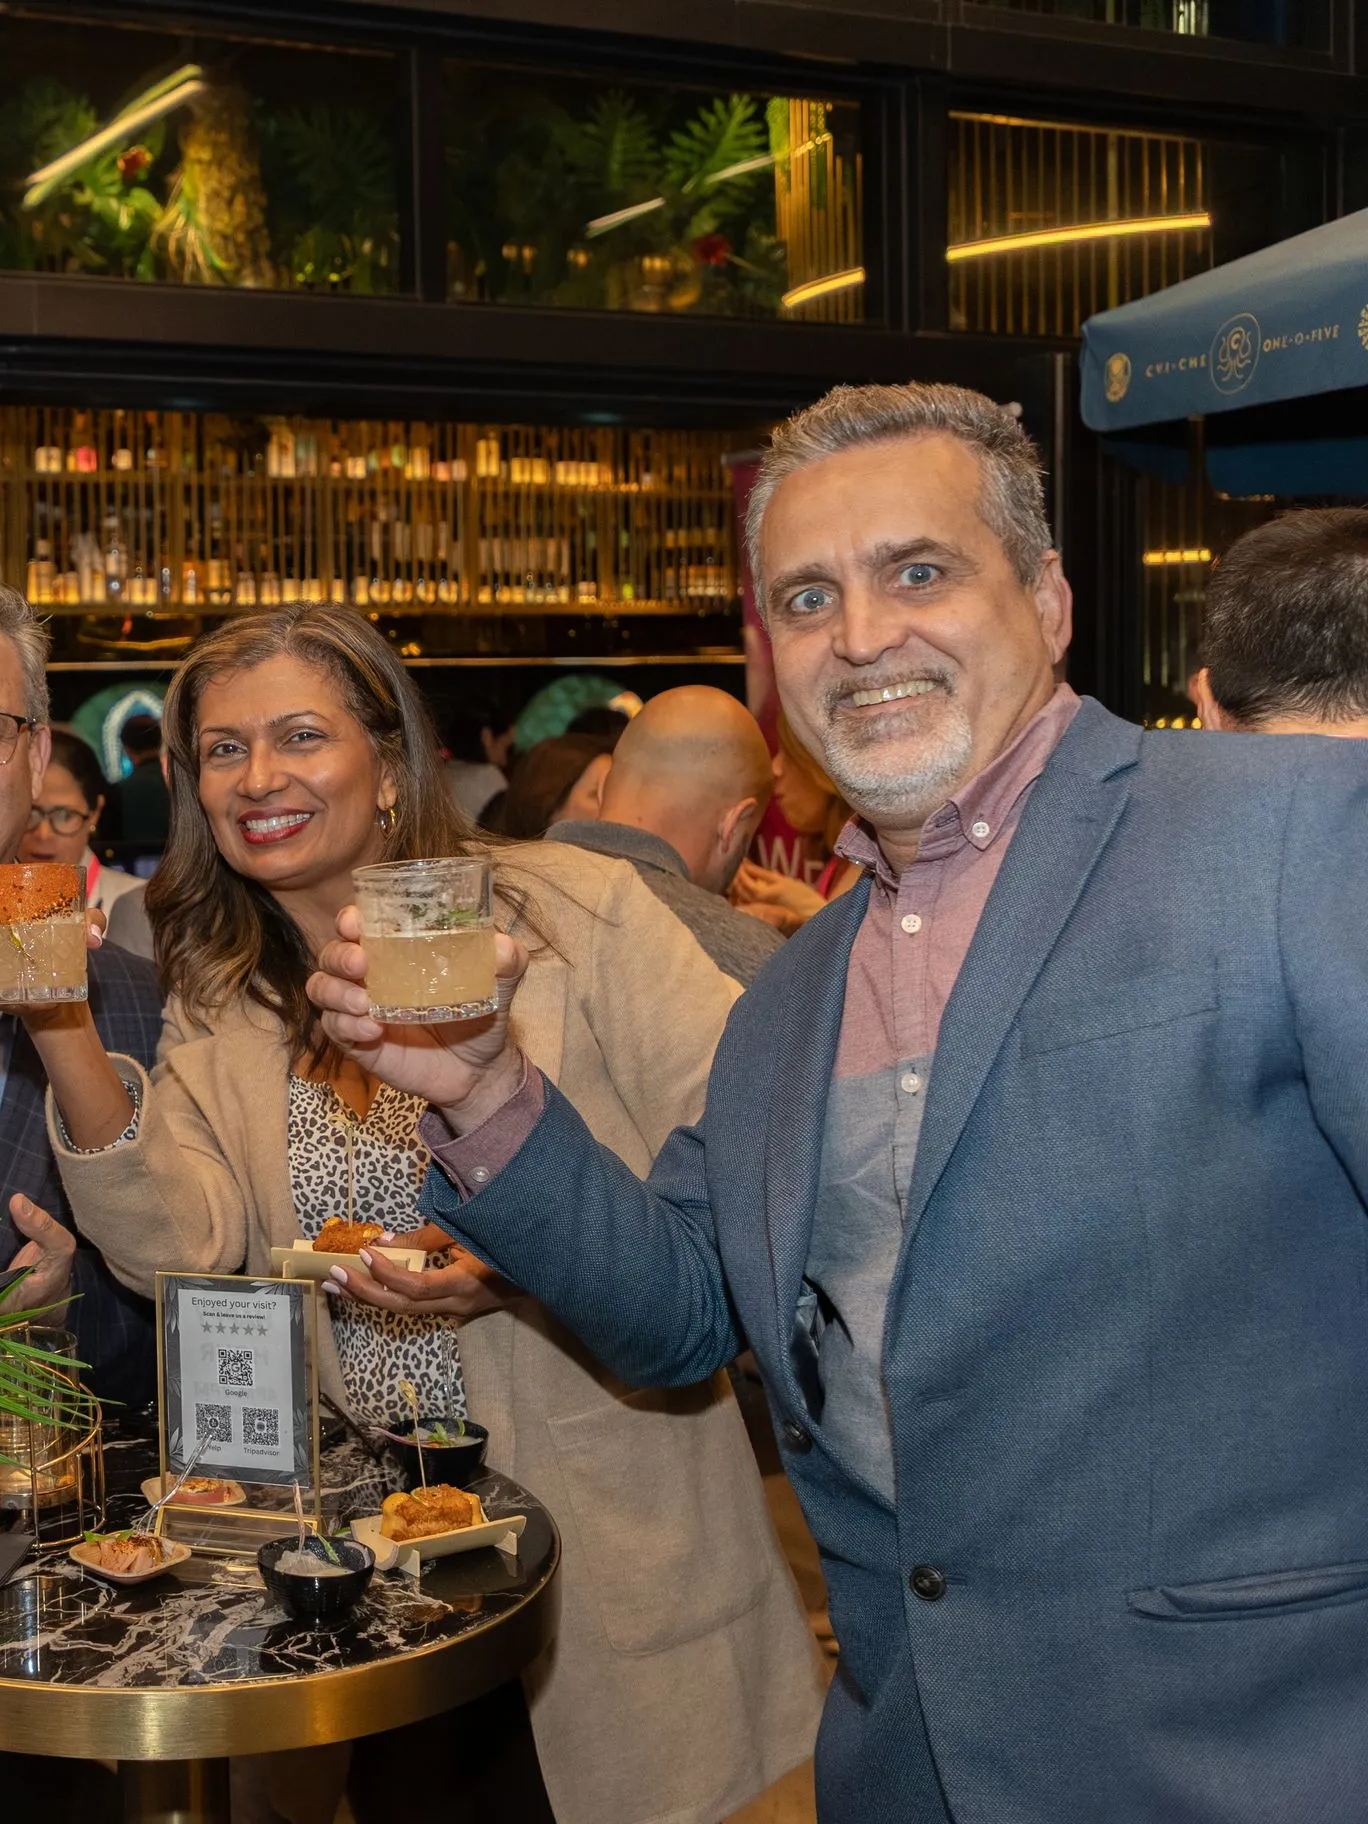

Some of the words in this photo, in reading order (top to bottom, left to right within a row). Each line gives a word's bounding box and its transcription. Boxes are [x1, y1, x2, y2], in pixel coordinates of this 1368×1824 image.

[191, 1297, 228, 1308] Enjoyed
[229, 1301, 250, 1310] your
[253, 1301, 277, 1310] visit?
[224, 1389, 248, 1398] Google
[243, 1447, 280, 1457] Tripadvisor
